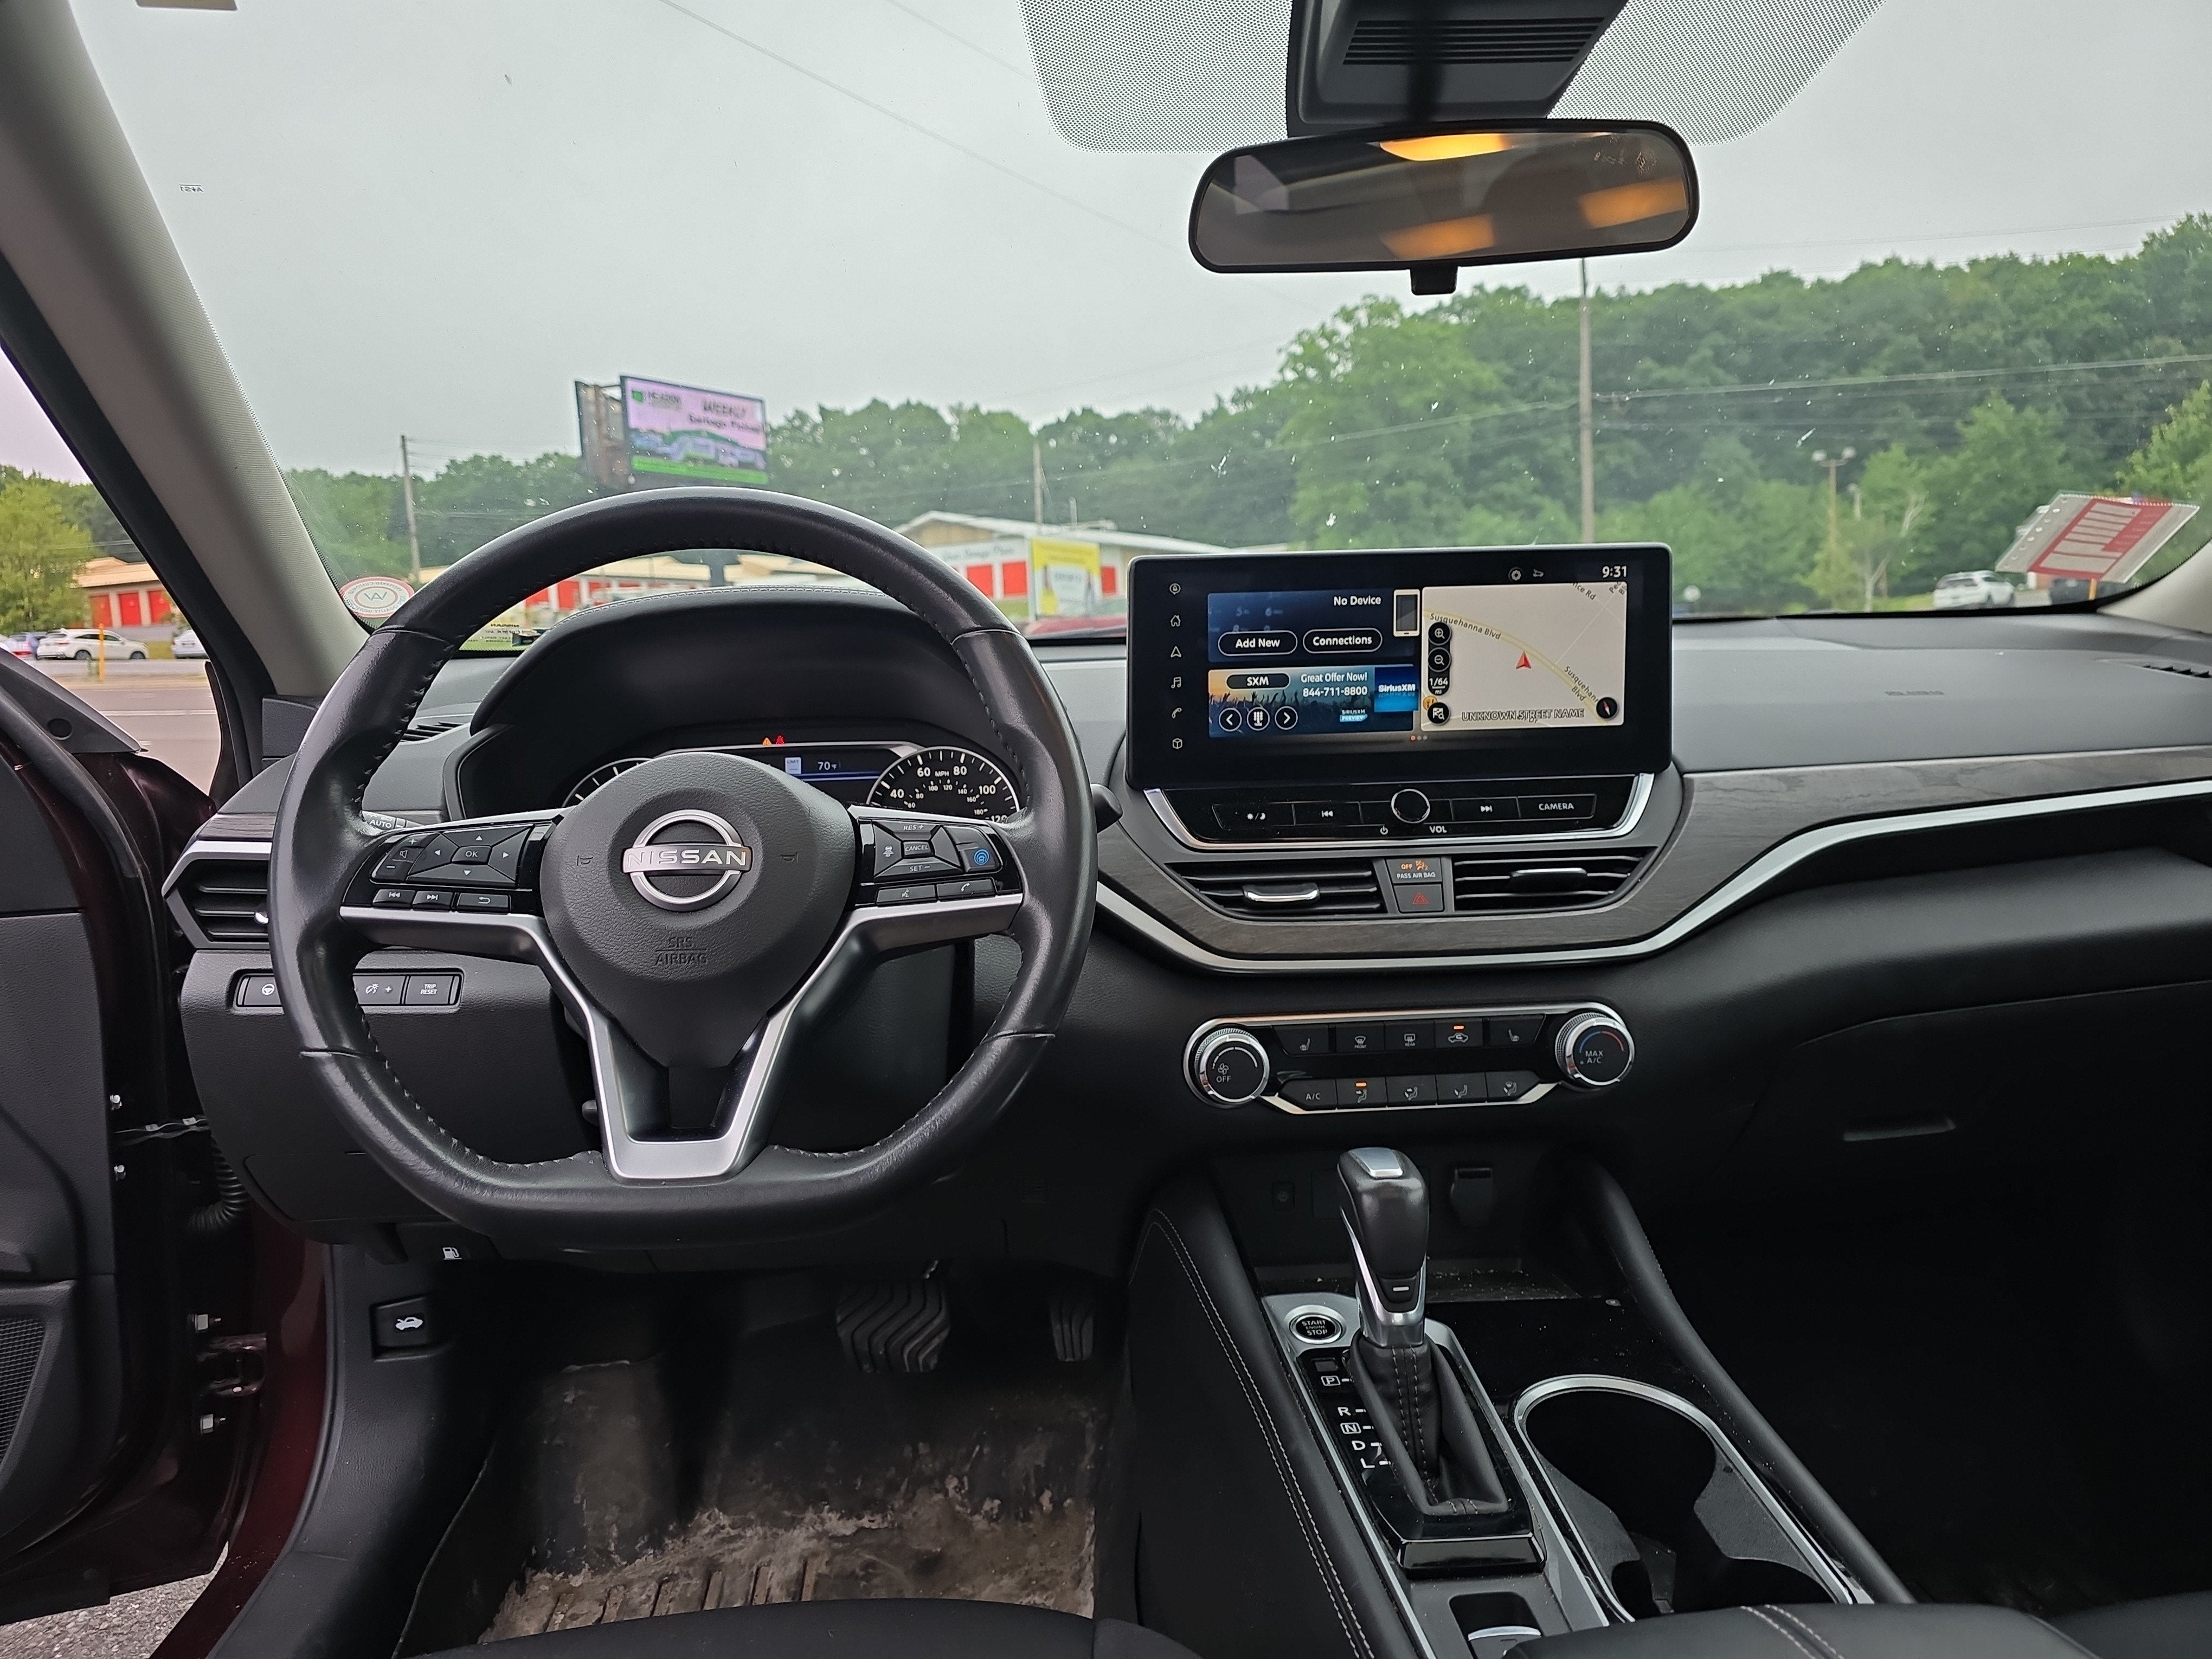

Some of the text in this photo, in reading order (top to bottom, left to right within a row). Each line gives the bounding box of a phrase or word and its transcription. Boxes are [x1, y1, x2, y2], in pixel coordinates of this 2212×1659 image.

[1602, 565, 1626, 578] 9:31
[1586, 589, 1596, 600] Rd
[1334, 595, 1381, 606] No Device
[1430, 613, 1501, 640] Susquehanna Blvd
[1236, 637, 1280, 648] Add New
[1313, 635, 1372, 646] Connections
[1246, 676, 1269, 686] SXM
[1301, 672, 1368, 683] Great Offer Now!
[1429, 677, 1448, 686] 1/64
[1564, 666, 1598, 703] Susquehann
[1303, 686, 1368, 697] 844-711-8800
[1571, 685, 1587, 702] Blvd
[1462, 710, 1517, 722] UNKNOWN
[1518, 709, 1553, 720] STREET
[1554, 708, 1585, 719] NAME
[917, 767, 931, 777] 60
[953, 766, 967, 776] 80
[890, 789, 904, 799] 40
[979, 785, 996, 795] 100
[1538, 802, 1574, 811] CAMERA
[369, 819, 392, 828] AUTO
[1429, 825, 1447, 833] VOL
[628, 848, 746, 867] NISSAN
[654, 952, 708, 967] AIRBAG
[1216, 1075, 1231, 1083] OFF
[1306, 1092, 1321, 1101] A/C
[1338, 1406, 1352, 1416] R
[1352, 1440, 1366, 1450] D
[1360, 1458, 1375, 1469] L
